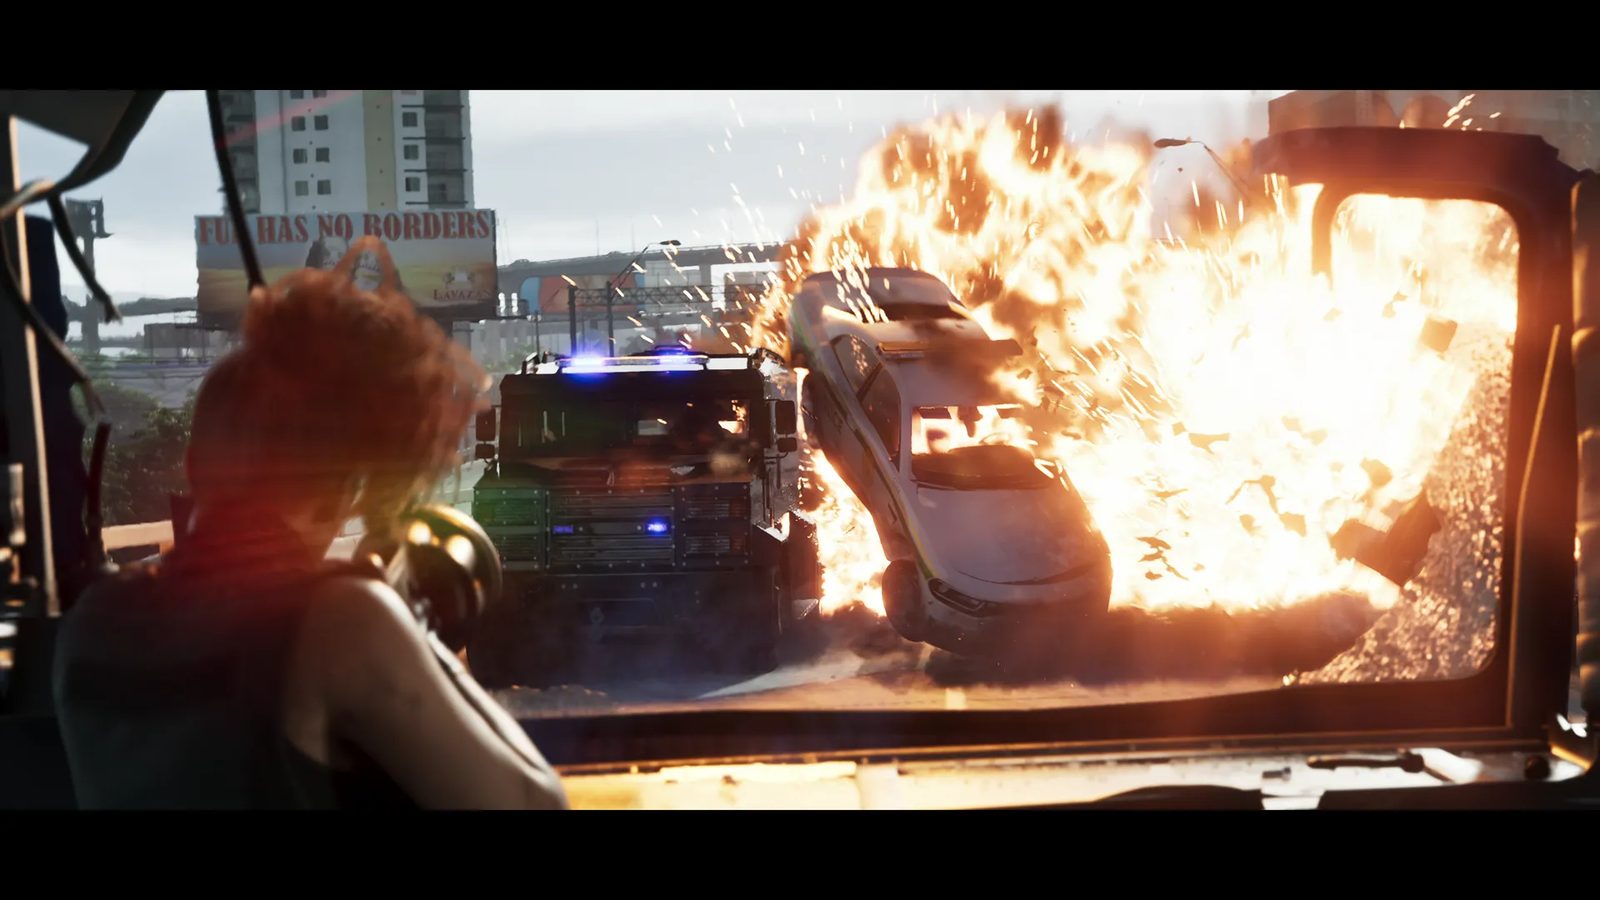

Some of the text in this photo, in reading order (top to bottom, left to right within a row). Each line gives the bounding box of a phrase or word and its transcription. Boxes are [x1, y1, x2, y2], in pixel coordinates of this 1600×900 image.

[256, 214, 309, 244] HAS
[317, 213, 353, 241] NO
[363, 210, 490, 241] BORDERS
